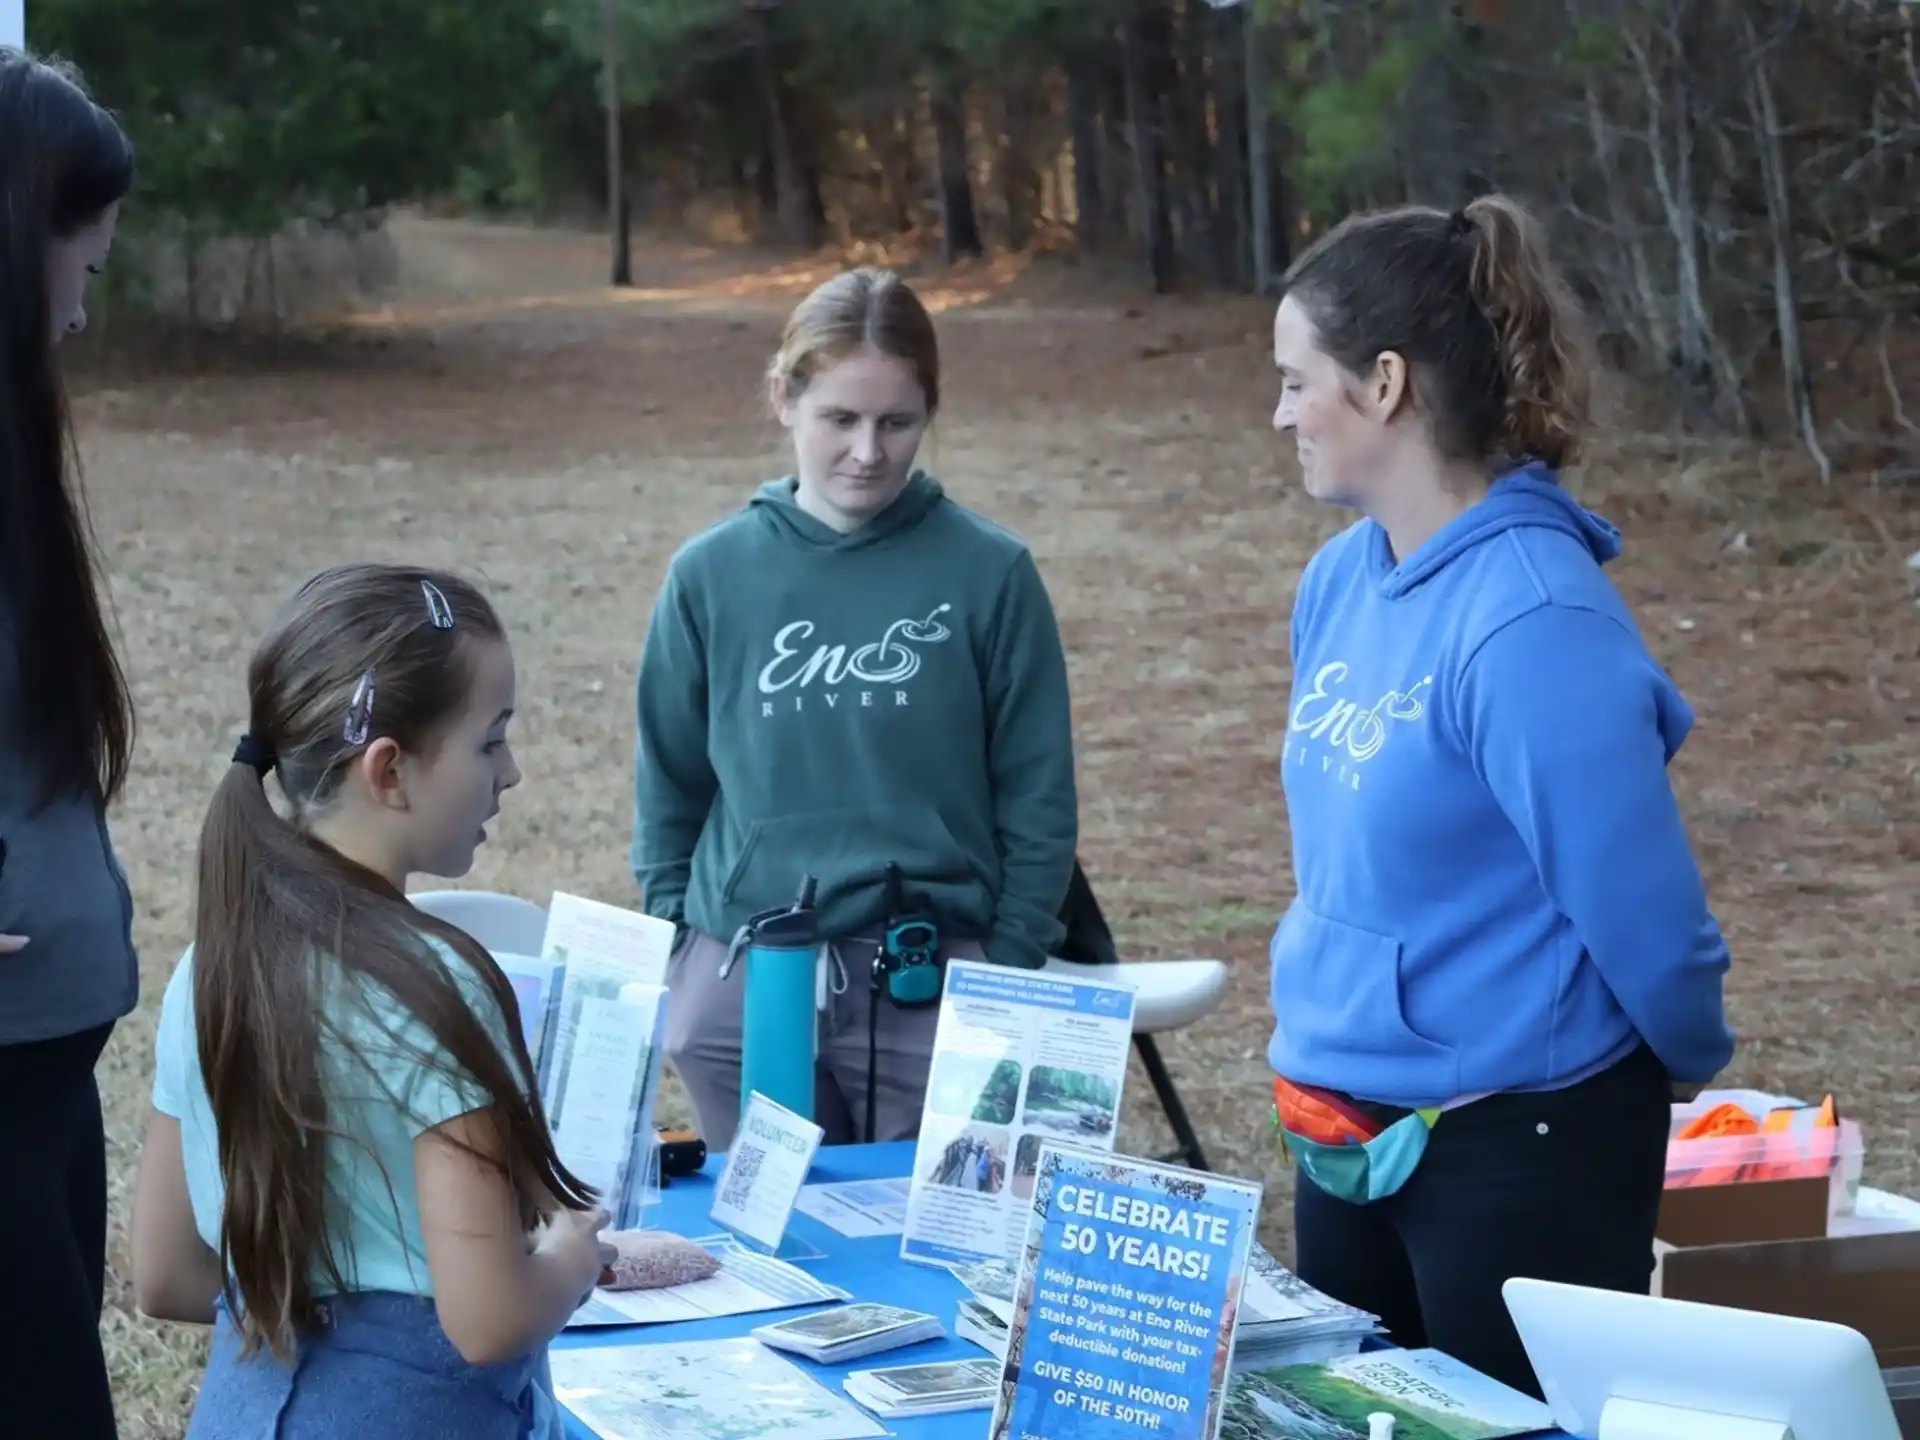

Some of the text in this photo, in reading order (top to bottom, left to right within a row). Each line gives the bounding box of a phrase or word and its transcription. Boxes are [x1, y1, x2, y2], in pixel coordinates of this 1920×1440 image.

[758, 603, 950, 693] Eno
[762, 691, 908, 717] RIVER
[1292, 661, 1433, 762] Eno
[1056, 1185, 1229, 1246] CELEBRATE
[1060, 1224, 1097, 1254] 50
[1105, 1232, 1211, 1281] YEARS!
[1040, 1289, 1210, 1338] next 50 years at Eno River
[1044, 1267, 1213, 1319] Help pave the way for the
[1039, 1306, 1203, 1357] State Park with your tax-
[1049, 1329, 1186, 1374] deductible donation!
[1033, 1360, 1190, 1413] GIVE $50 IN HONOR
[1053, 1389, 1161, 1430] OF THE 50TH!
[1372, 1362, 1465, 1408] STRATEGIC
